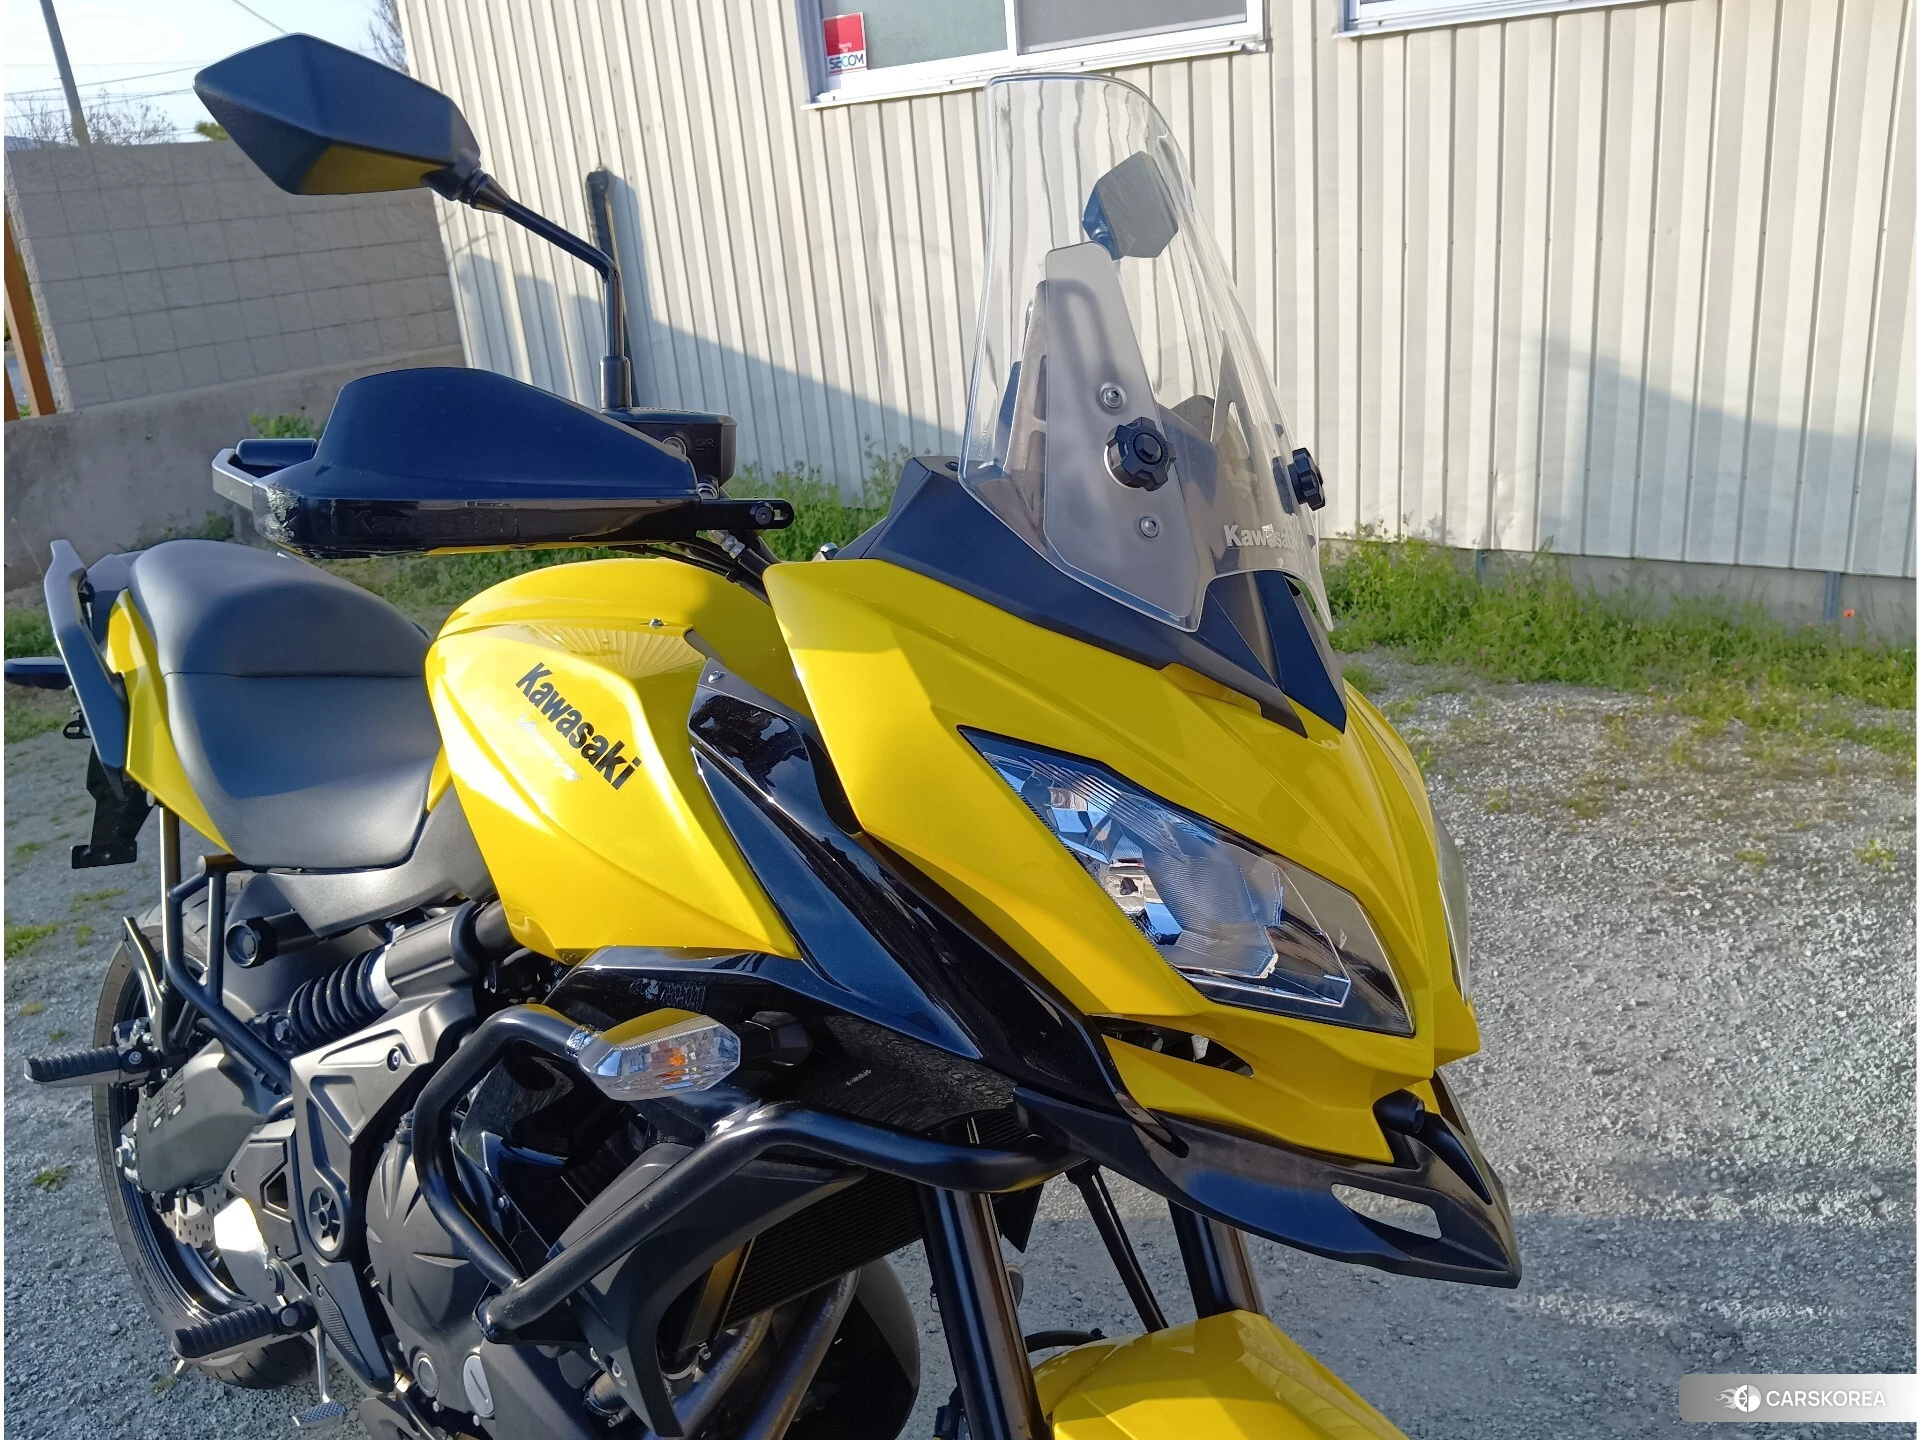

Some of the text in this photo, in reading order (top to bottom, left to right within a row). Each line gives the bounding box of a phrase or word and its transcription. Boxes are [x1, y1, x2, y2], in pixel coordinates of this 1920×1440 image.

[829, 53, 864, 69] SECOM
[1223, 524, 1303, 552] Kawasa
[515, 662, 642, 790] Kawasaki
